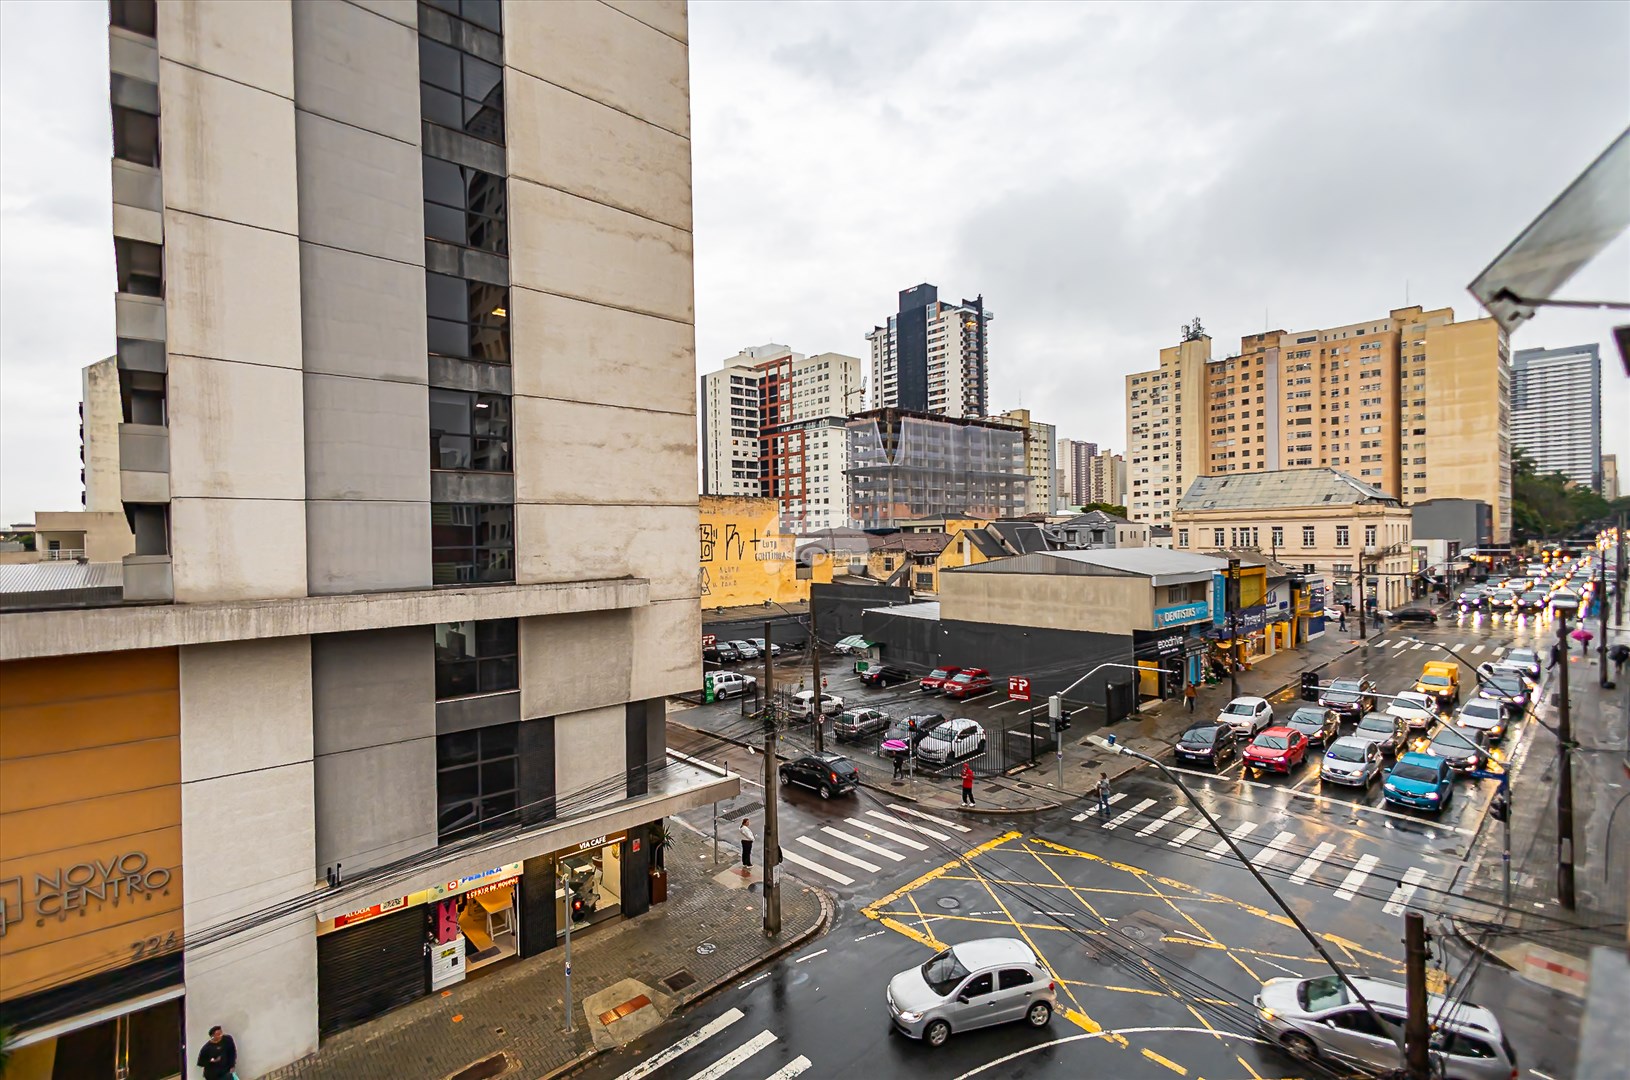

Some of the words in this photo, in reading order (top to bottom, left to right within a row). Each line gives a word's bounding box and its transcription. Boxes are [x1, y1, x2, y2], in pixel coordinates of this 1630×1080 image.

[1164, 607, 1196, 622] DENTISTAS
[1157, 635, 1184, 649] ecodrive
[579, 841, 590, 849] VIA
[590, 835, 607, 846] CAFÉ
[34, 851, 148, 895] NOVO
[36, 868, 170, 915] CENTRO
[36, 889, 170, 928] CURITIBA
[344, 906, 371, 918] ALUGA
[130, 930, 178, 961] 226
